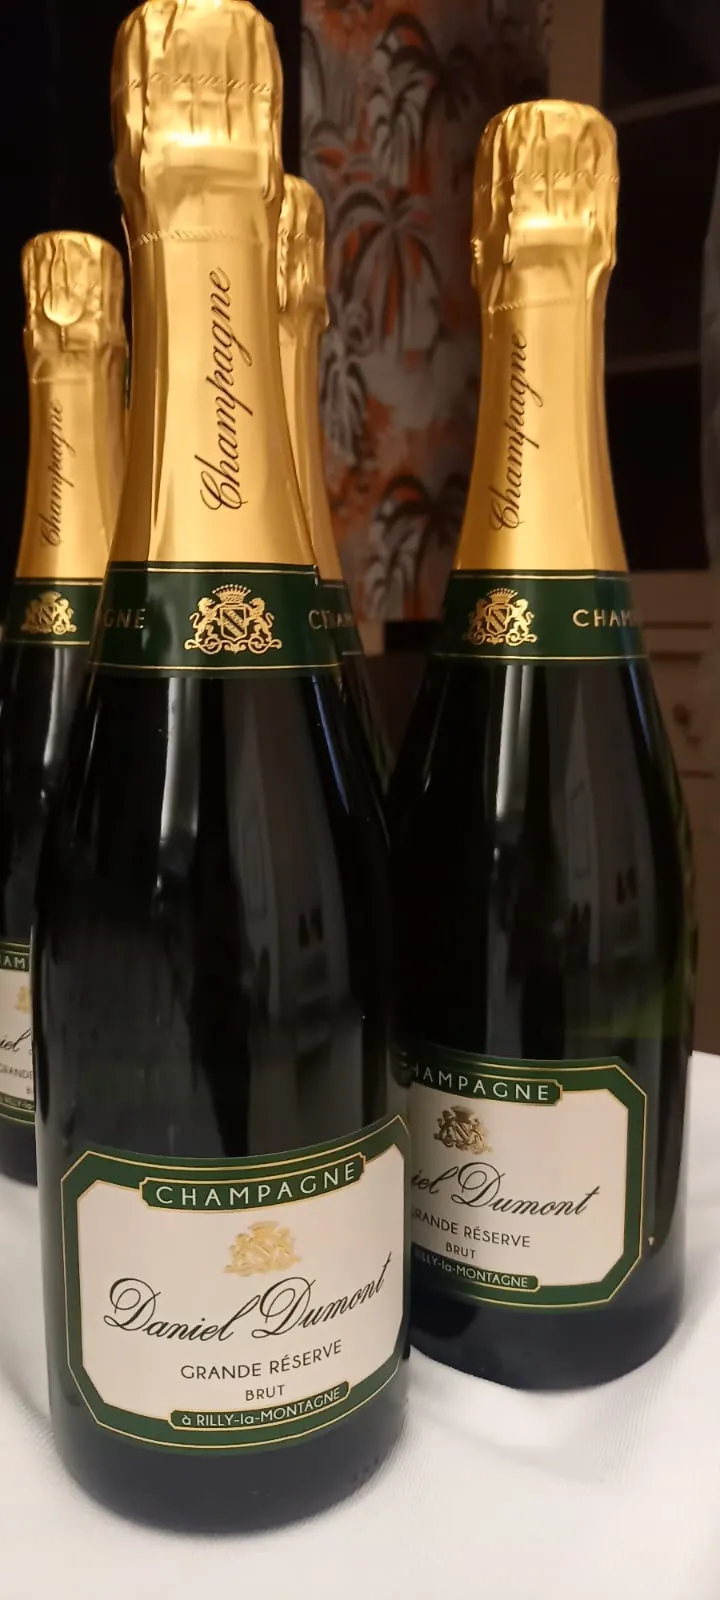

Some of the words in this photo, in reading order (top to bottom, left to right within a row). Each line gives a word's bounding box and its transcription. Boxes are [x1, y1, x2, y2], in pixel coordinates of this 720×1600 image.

[194, 267, 253, 510] Champagne
[488, 330, 543, 530] Champagne
[38, 398, 76, 546] Champagne
[155, 1161, 356, 1207] CHAMPAGNE
[451, 1161, 600, 1216] Dumont
[410, 1206, 458, 1236] RANDE
[464, 1225, 531, 1249] RÉSERVE
[445, 1242, 476, 1260] BRUT
[103, 1277, 261, 1342] Daniel
[251, 1250, 393, 1340] Dumont
[180, 1364, 262, 1380] GRANDE
[268, 1338, 343, 1375] RÉSERVE
[181, 1412, 192, 1426] à
[195, 1385, 342, 1427] RILLY-la-MONTAGNE
[245, 1384, 286, 1402] BRUT
